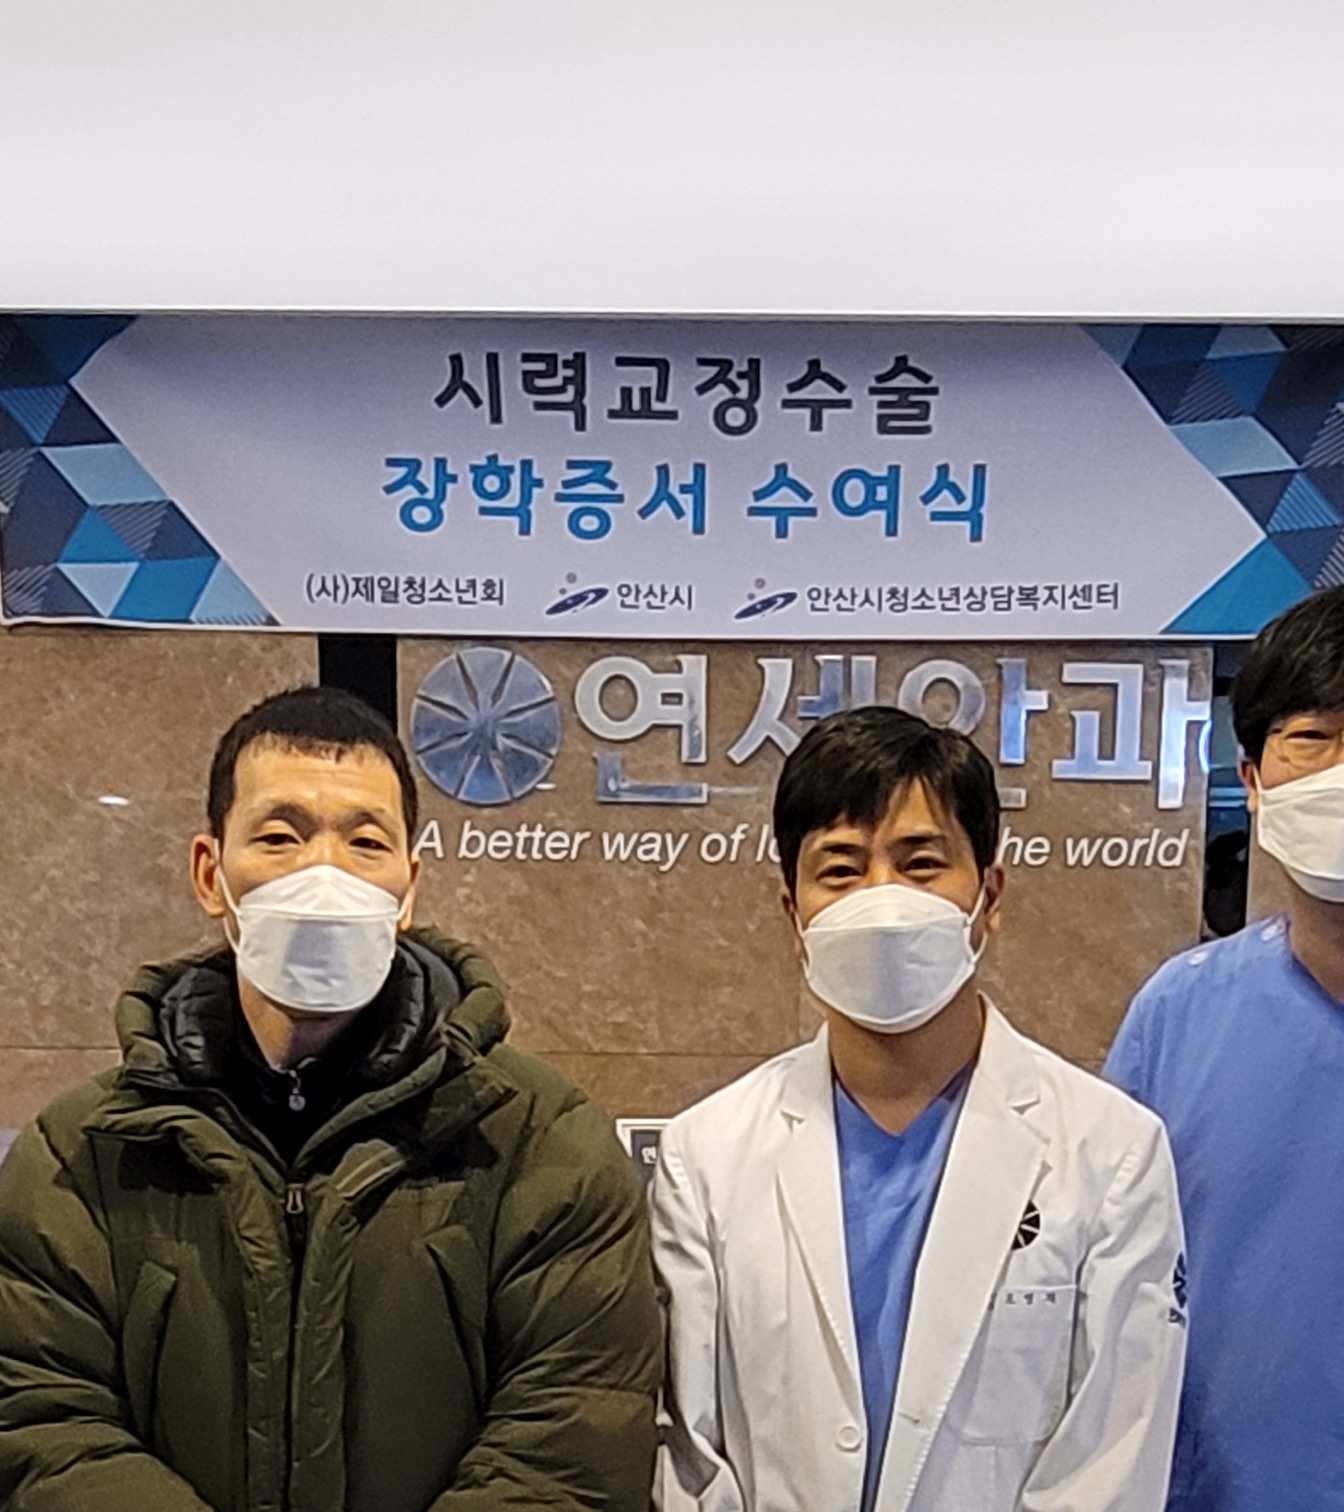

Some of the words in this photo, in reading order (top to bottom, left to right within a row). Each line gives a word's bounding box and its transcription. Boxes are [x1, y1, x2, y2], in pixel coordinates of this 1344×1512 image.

[434, 350, 940, 437] 시력교정수술
[381, 454, 707, 541] 장학증서
[746, 461, 990, 544] 수여식
[305, 572, 506, 607] (사)제일청소년회
[616, 582, 694, 612] 안산시
[806, 582, 1121, 613] 안산시청소년상담복지센터
[575, 654, 1211, 809] 연세안과
[412, 820, 444, 860] A
[458, 820, 591, 861] better
[601, 829, 690, 873] way
[699, 823, 750, 864] of
[996, 828, 1051, 867] he
[1064, 827, 1190, 868] world
